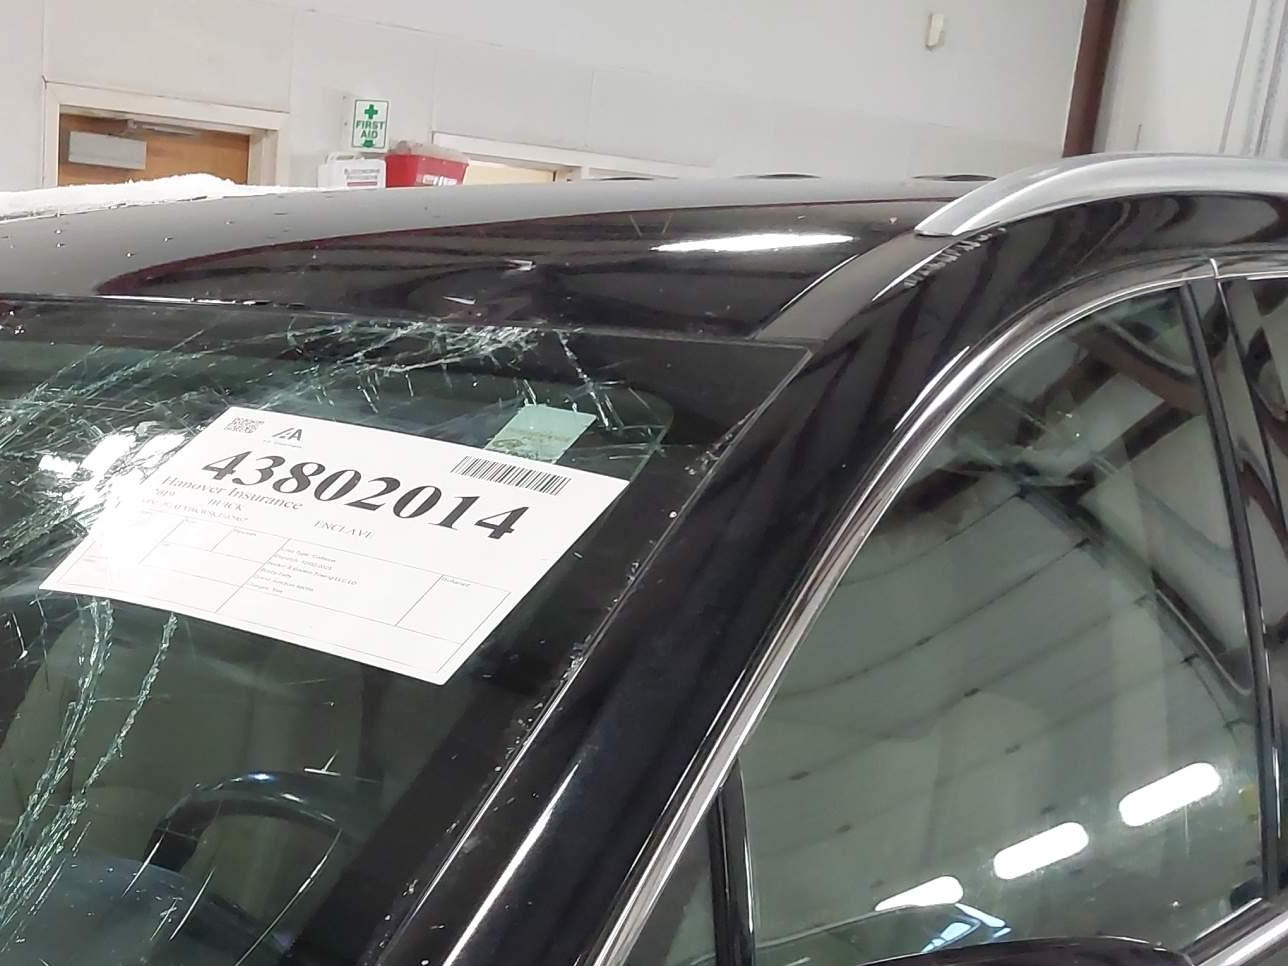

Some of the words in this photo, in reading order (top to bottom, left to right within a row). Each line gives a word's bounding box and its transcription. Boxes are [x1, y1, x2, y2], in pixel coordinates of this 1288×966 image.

[355, 120, 385, 130] FIRST
[360, 129, 378, 139] AID
[161, 475, 227, 495] Hanover
[228, 487, 304, 511] Insurance
[201, 450, 529, 540] 43802014
